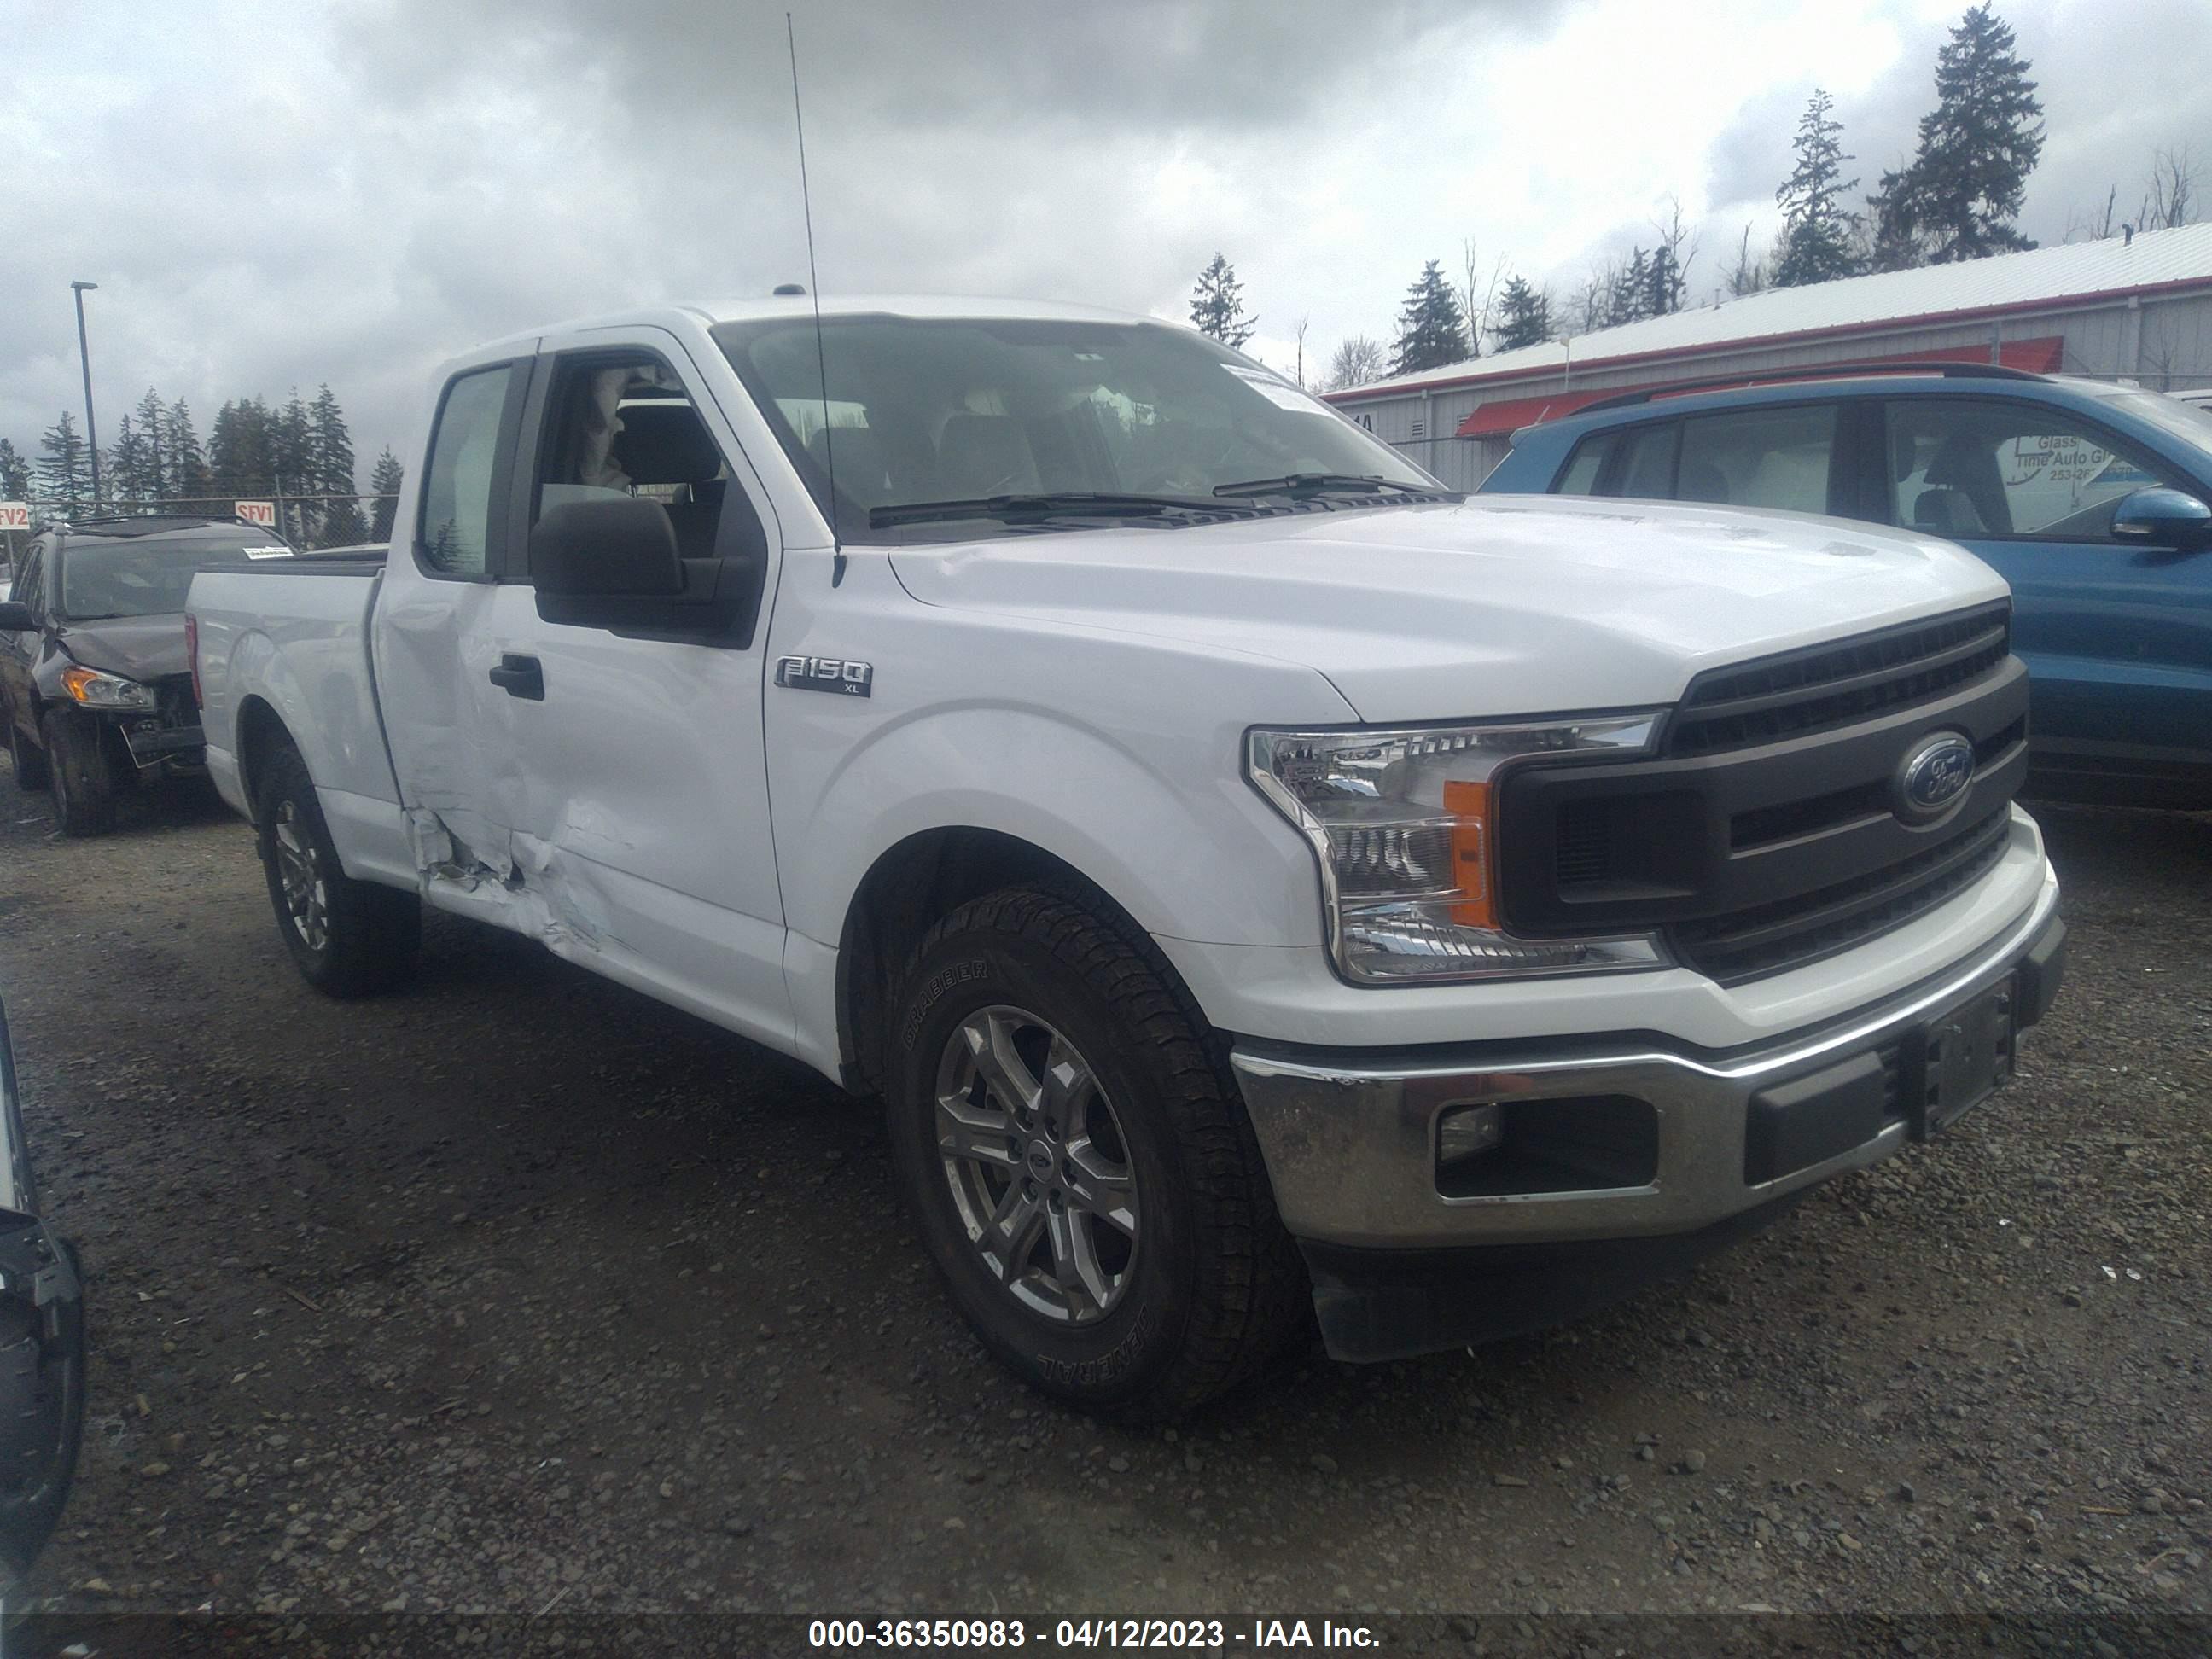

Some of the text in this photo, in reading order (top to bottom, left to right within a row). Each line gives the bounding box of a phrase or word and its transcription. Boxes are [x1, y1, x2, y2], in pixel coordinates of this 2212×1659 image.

[2038, 436, 2077, 449] Glass
[2017, 454, 2048, 468] Time
[2053, 451, 2087, 466] Auto
[237, 504, 273, 521] SFV1
[844, 684, 859, 694] XL
[902, 959, 988, 1051] GRABBER
[1037, 1303, 1155, 1384] GENERAL
